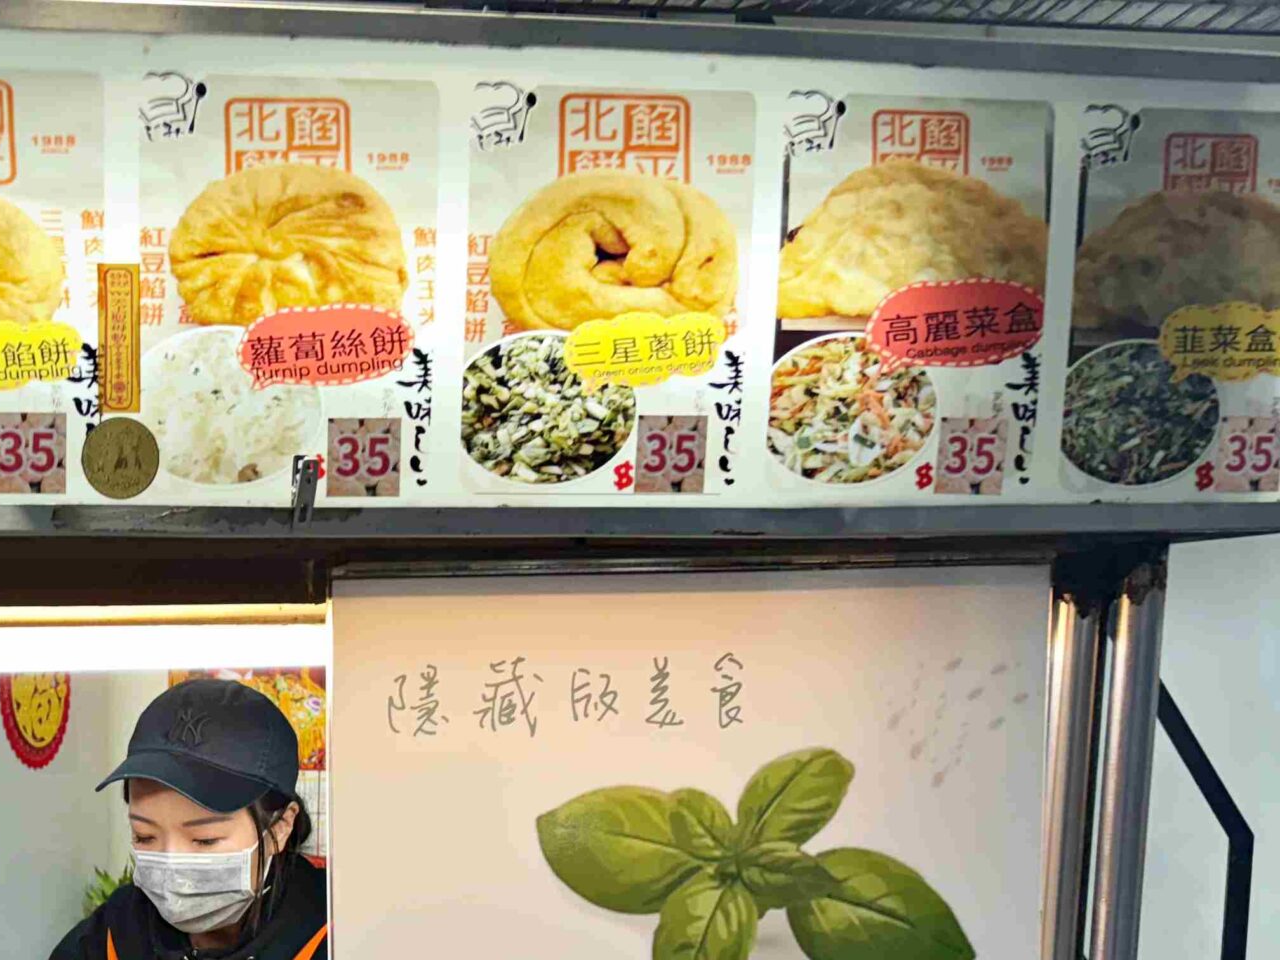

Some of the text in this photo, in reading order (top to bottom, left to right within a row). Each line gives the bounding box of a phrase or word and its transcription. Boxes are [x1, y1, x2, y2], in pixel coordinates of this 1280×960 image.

[31, 134, 76, 147] 1988
[368, 152, 410, 163] 1988
[707, 153, 752, 166] 1988
[882, 301, 1041, 347] 高麗菜盒
[248, 325, 407, 367] 蘿蔔絲餅
[573, 328, 715, 367] 三星蔥餅
[906, 345, 968, 359] Cabbage
[253, 357, 404, 382] Turnip dumpling
[593, 368, 625, 378] Green
[629, 365, 663, 375] onions
